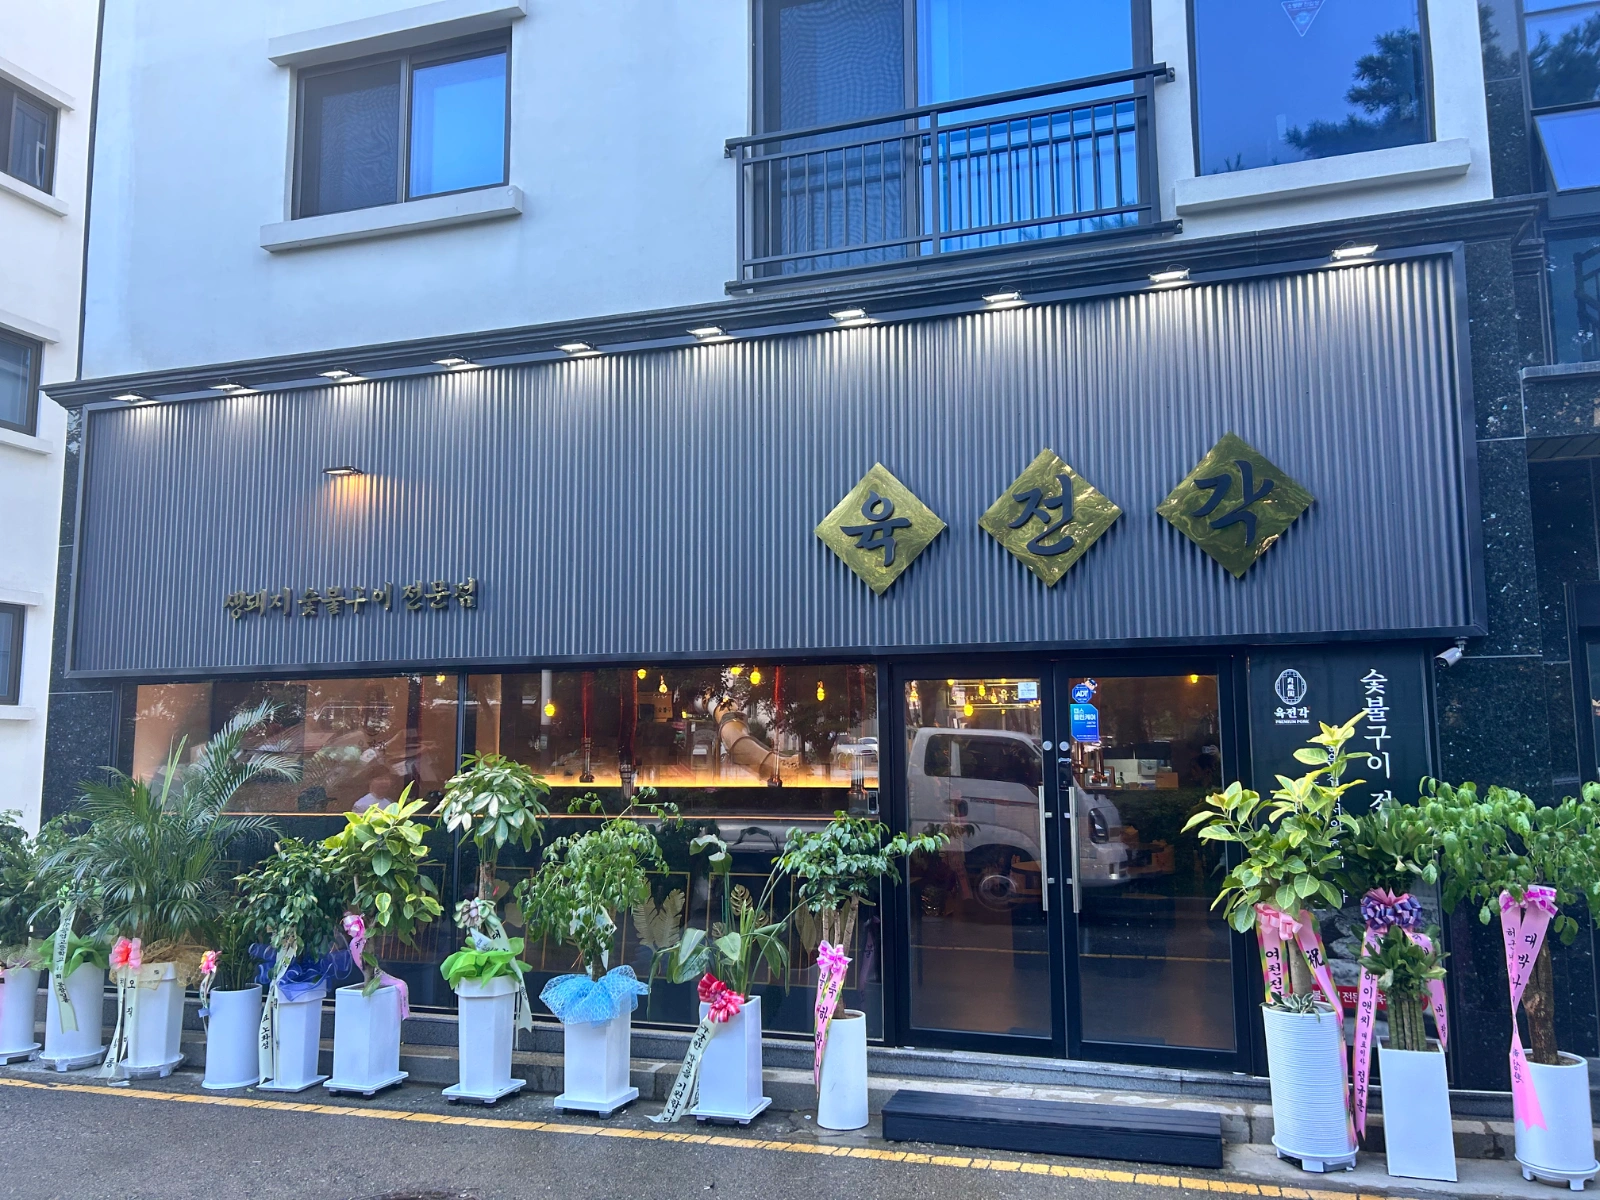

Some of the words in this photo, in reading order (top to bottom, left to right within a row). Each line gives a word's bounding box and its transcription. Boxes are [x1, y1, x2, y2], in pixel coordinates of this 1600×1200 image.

[840, 459, 1275, 568] 육전각
[223, 586, 292, 619] 생돼지
[297, 581, 394, 616] 숯불구이
[401, 576, 478, 610] 전문점
[1274, 706, 1310, 719] 육전각
[1360, 668, 1392, 779] 숯불구이
